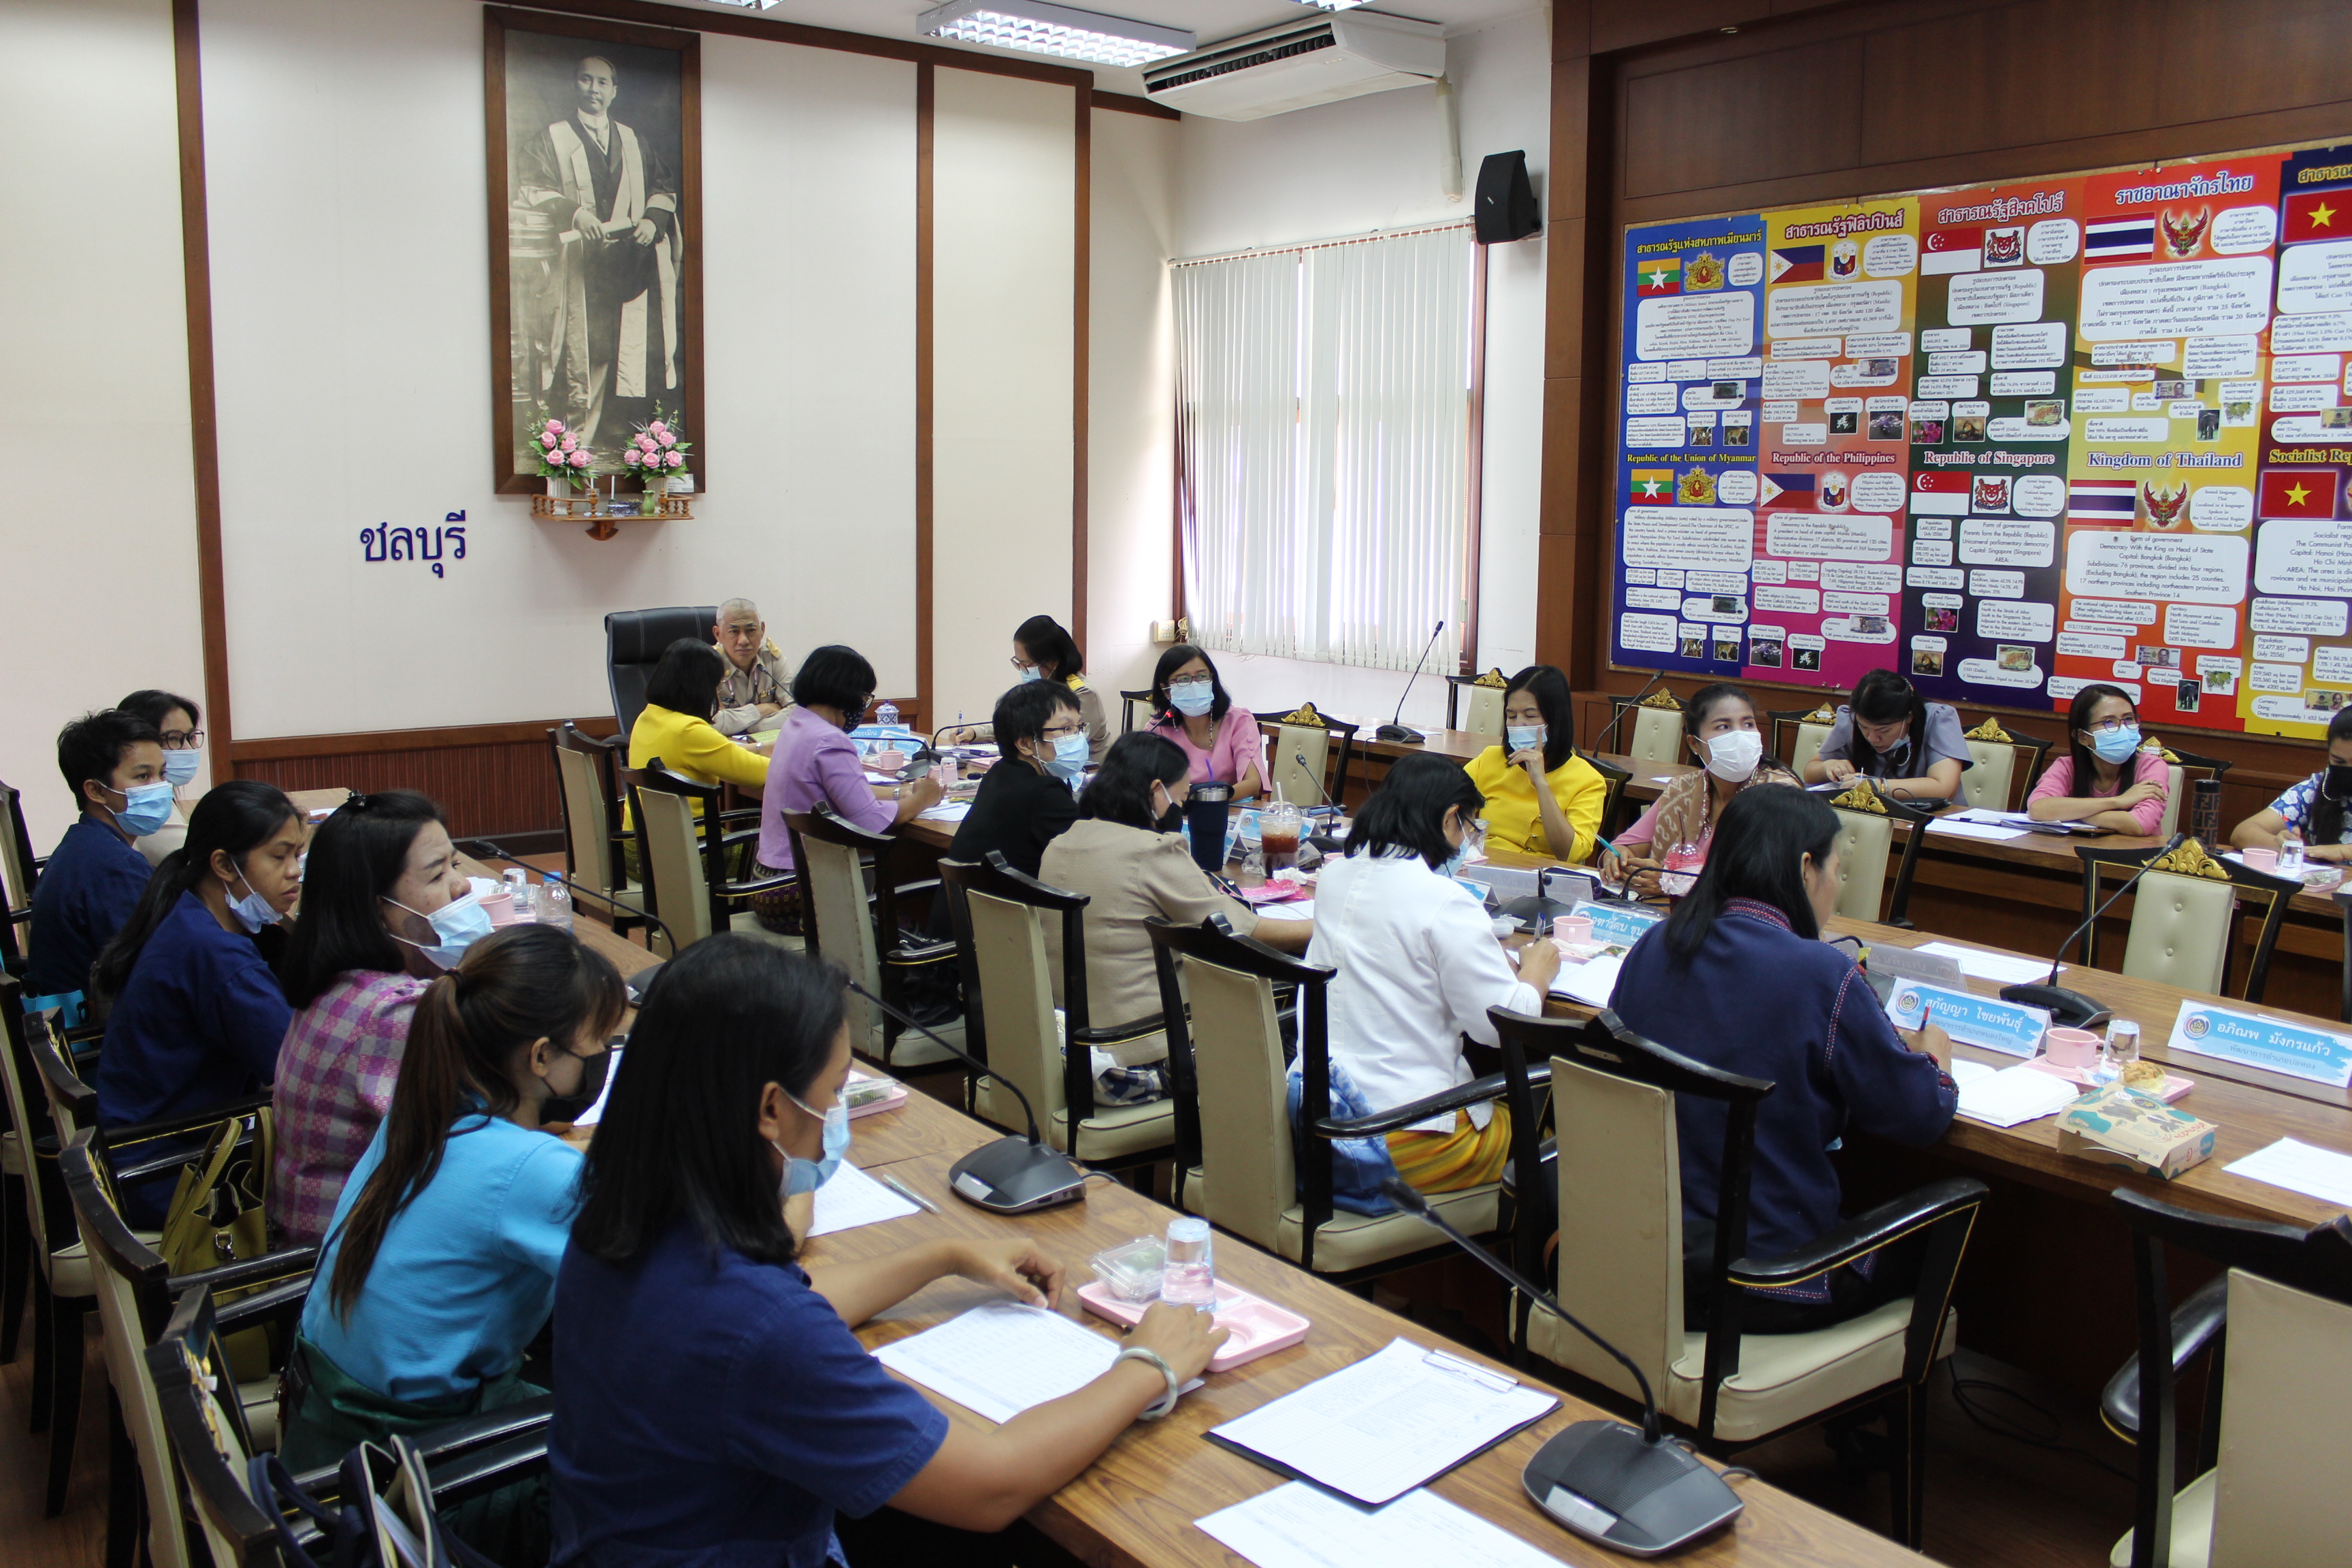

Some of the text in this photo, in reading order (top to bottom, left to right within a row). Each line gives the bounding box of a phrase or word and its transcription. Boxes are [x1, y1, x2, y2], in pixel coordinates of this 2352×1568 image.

[2115, 172, 2253, 205] ราชอาณาจักรไทย
[1938, 190, 2065, 224] สาธารณรัฐสิงคโปร์
[1784, 209, 1904, 240] สาธารณรัฐฟิลิปปินส์
[1637, 229, 1762, 255] สาธารณรัฐแห่งสหภาพเมียนมาร์
[1627, 453, 1756, 464] Republic of the Union of Myanmar
[1773, 452, 1895, 465] Republic of the Philippines
[1924, 451, 2055, 467] Republic of Singapore
[2087, 452, 2242, 470] Kingdom of Thailand
[2269, 449, 2325, 463] Socialist
[359, 510, 466, 578] ชลบุรี
[2165, 555, 2191, 563] (Bangkok)
[2086, 570, 2111, 578] (Excluding
[2136, 581, 2159, 589] including
[2161, 582, 2193, 590] northeastern
[1925, 997, 2024, 1033] สกัญญา ไชยพันธุ์
[2217, 1022, 2331, 1056] อภิณพ มังกรแก้ว
